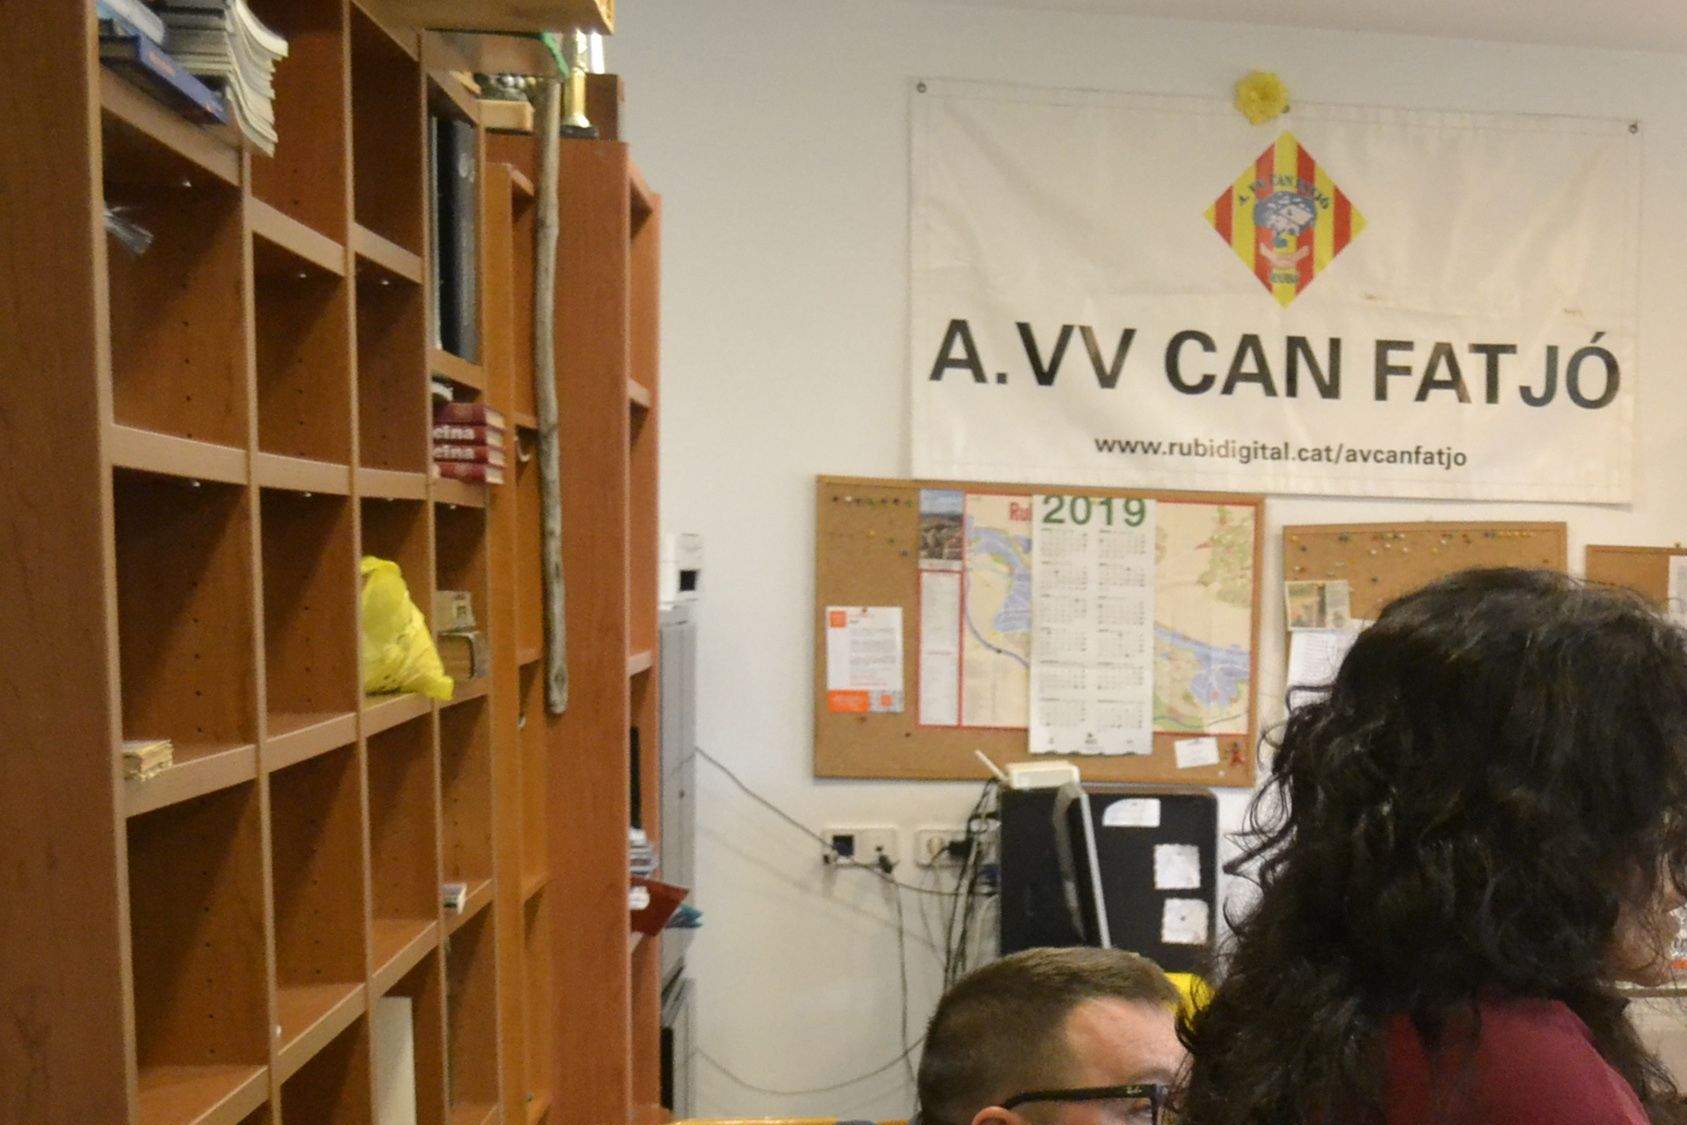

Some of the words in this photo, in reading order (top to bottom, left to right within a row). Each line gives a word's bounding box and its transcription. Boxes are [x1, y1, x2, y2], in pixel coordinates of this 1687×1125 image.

[929, 318, 1137, 391] A.VV
[1164, 329, 1343, 400] CAN
[1373, 331, 1622, 410] FATJÓ
[1094, 437, 1468, 469] www.rubidigital.cat/avcanfatjo
[1041, 494, 1146, 527] 2019
